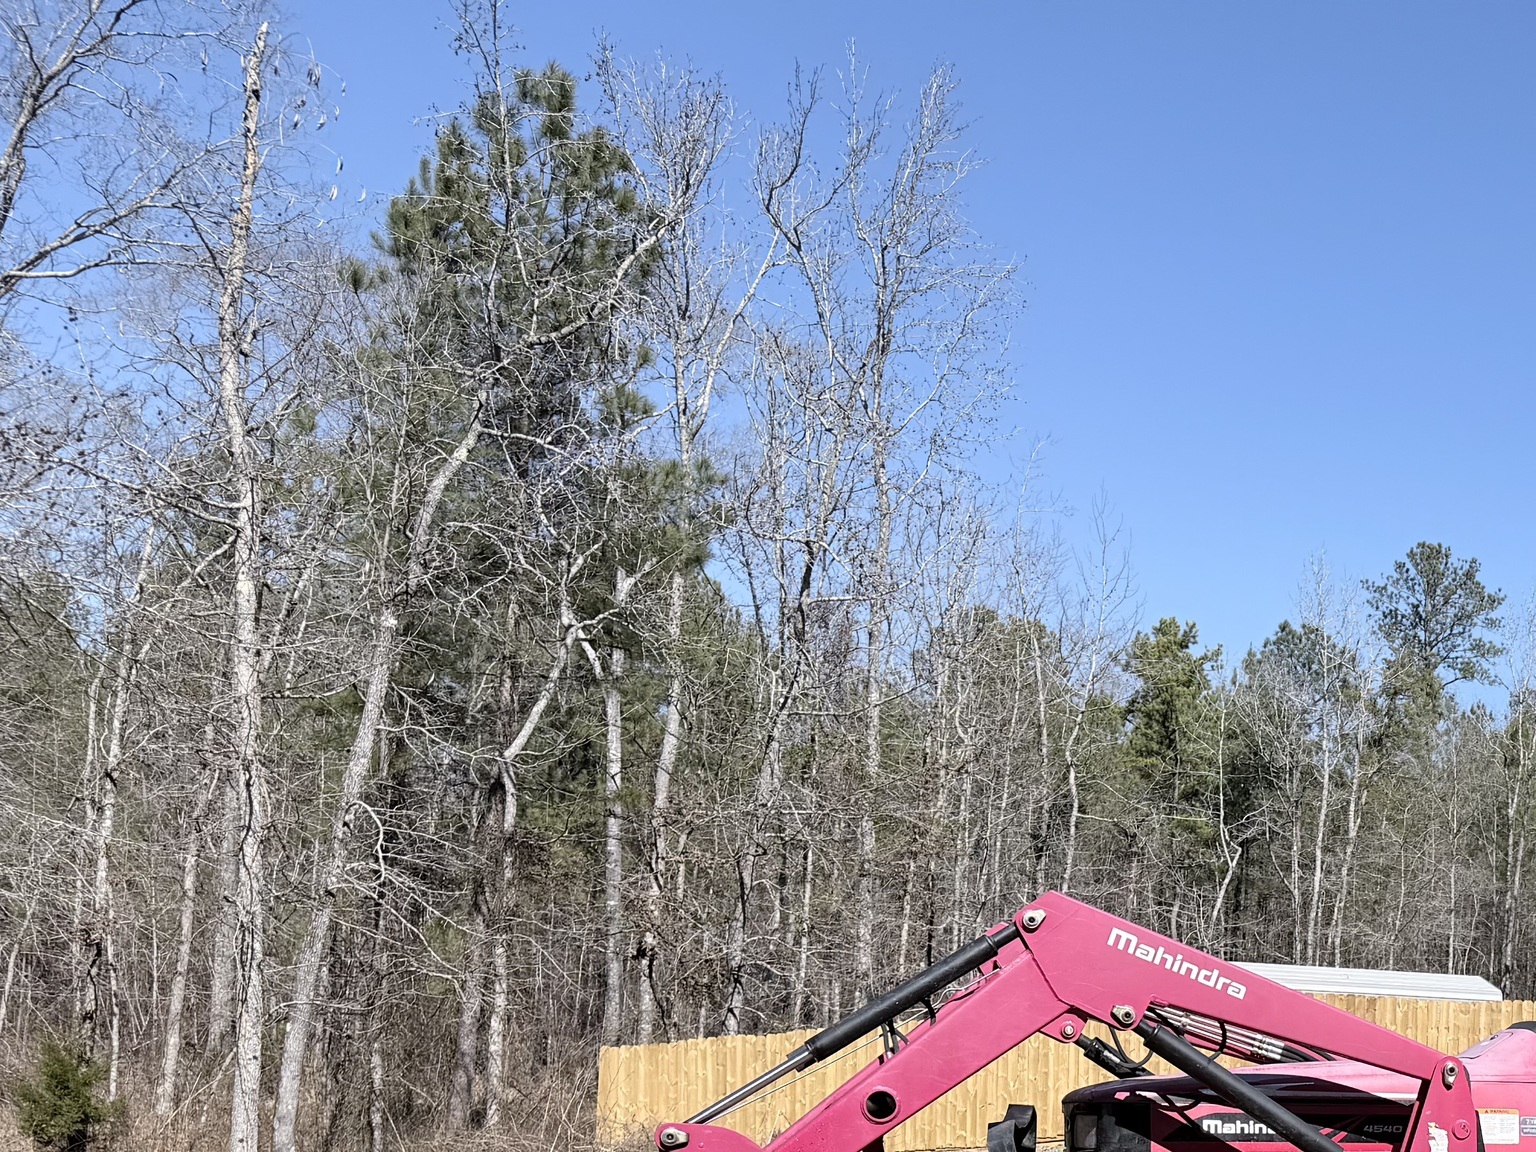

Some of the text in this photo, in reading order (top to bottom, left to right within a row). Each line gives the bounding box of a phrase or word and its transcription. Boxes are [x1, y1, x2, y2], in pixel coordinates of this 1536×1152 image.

[1107, 927, 1247, 1000] Mahindra
[1202, 1119, 1277, 1135] Mahin
[1363, 1125, 1403, 1133] 4540
